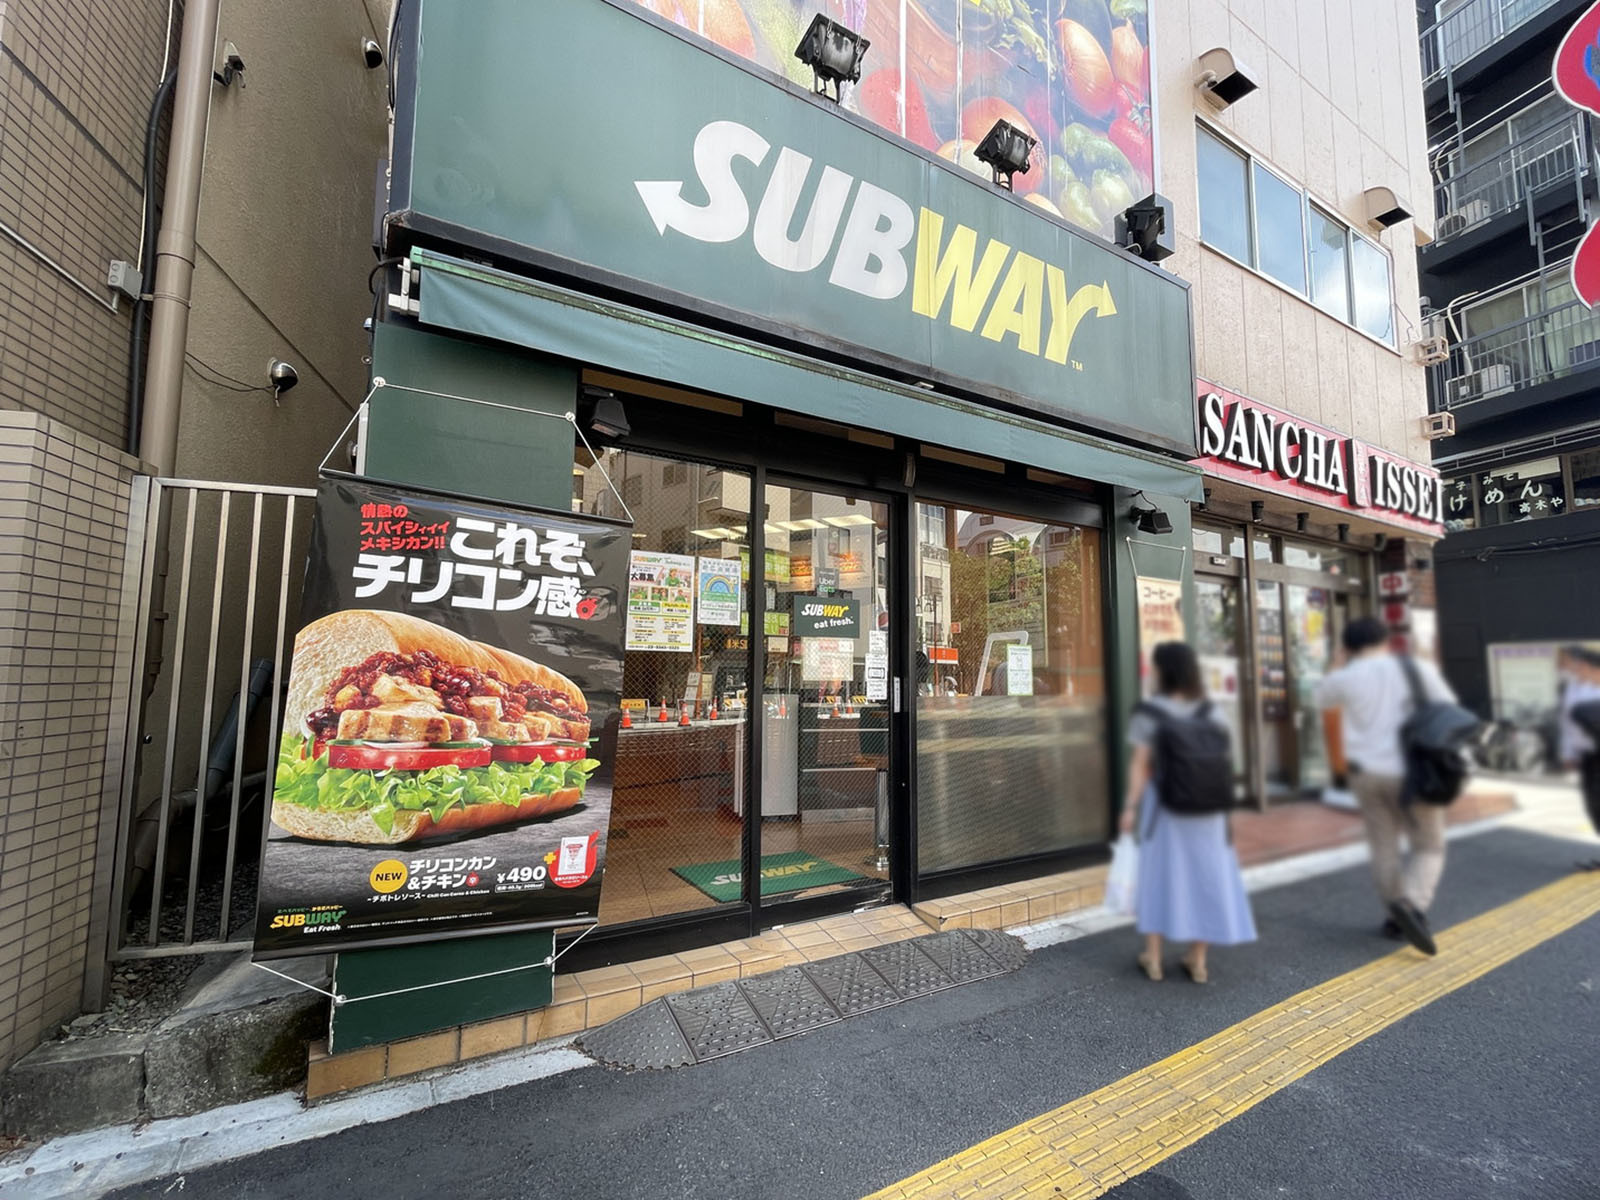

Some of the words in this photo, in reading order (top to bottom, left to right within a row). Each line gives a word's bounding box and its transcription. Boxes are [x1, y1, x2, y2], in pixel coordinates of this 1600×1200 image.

[634, 120, 1117, 366] SUBWAY
[1203, 392, 1348, 494] SANCHA
[1374, 455, 1444, 523] ISSEI
[818, 577, 835, 585] Uber
[801, 604, 849, 617] SUBWAY
[814, 620, 828, 629] eat
[409, 856, 497, 874] チリコンカン
[711, 862, 817, 885] SUWAY
[375, 872, 403, 881] NEW
[497, 866, 547, 883] ¥490
[270, 910, 347, 929] SUBWAY
[303, 926, 318, 934] Eat
[318, 924, 341, 933] Fresh
